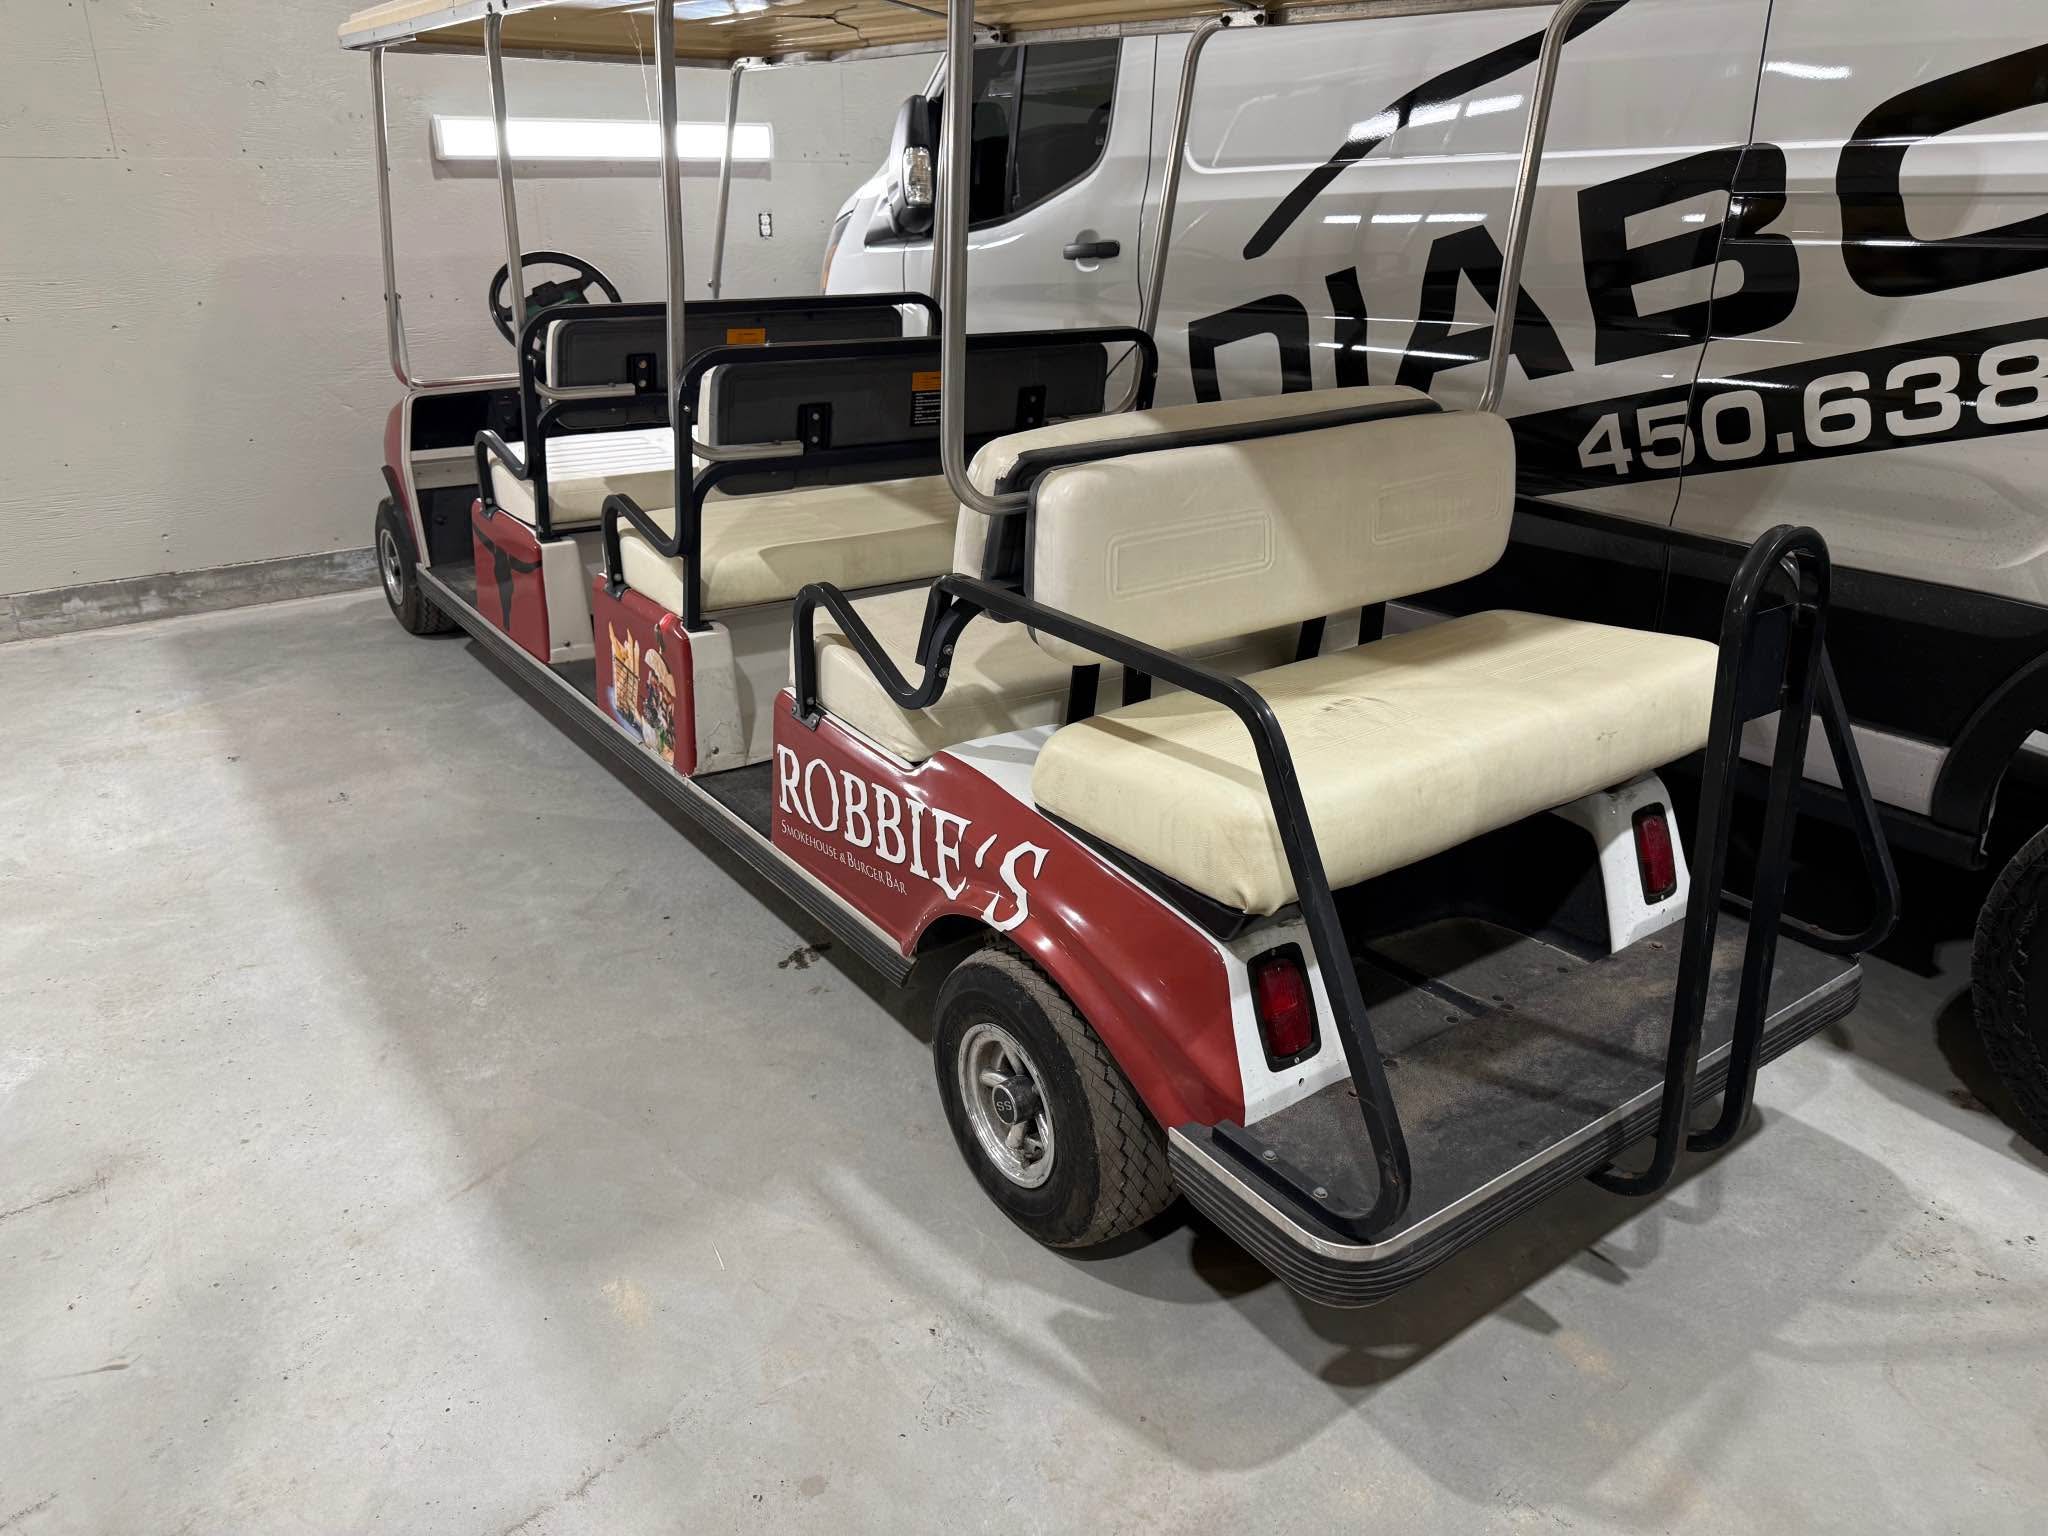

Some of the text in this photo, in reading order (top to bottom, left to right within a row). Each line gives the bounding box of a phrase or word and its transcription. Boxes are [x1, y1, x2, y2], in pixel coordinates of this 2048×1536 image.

[1577, 339, 2048, 475] 450.638
[776, 743, 1050, 932] ROBBIE'S
[781, 819, 907, 896] SMOKEHOUSE & BURGER BAR
[996, 1100, 1012, 1111] SS
